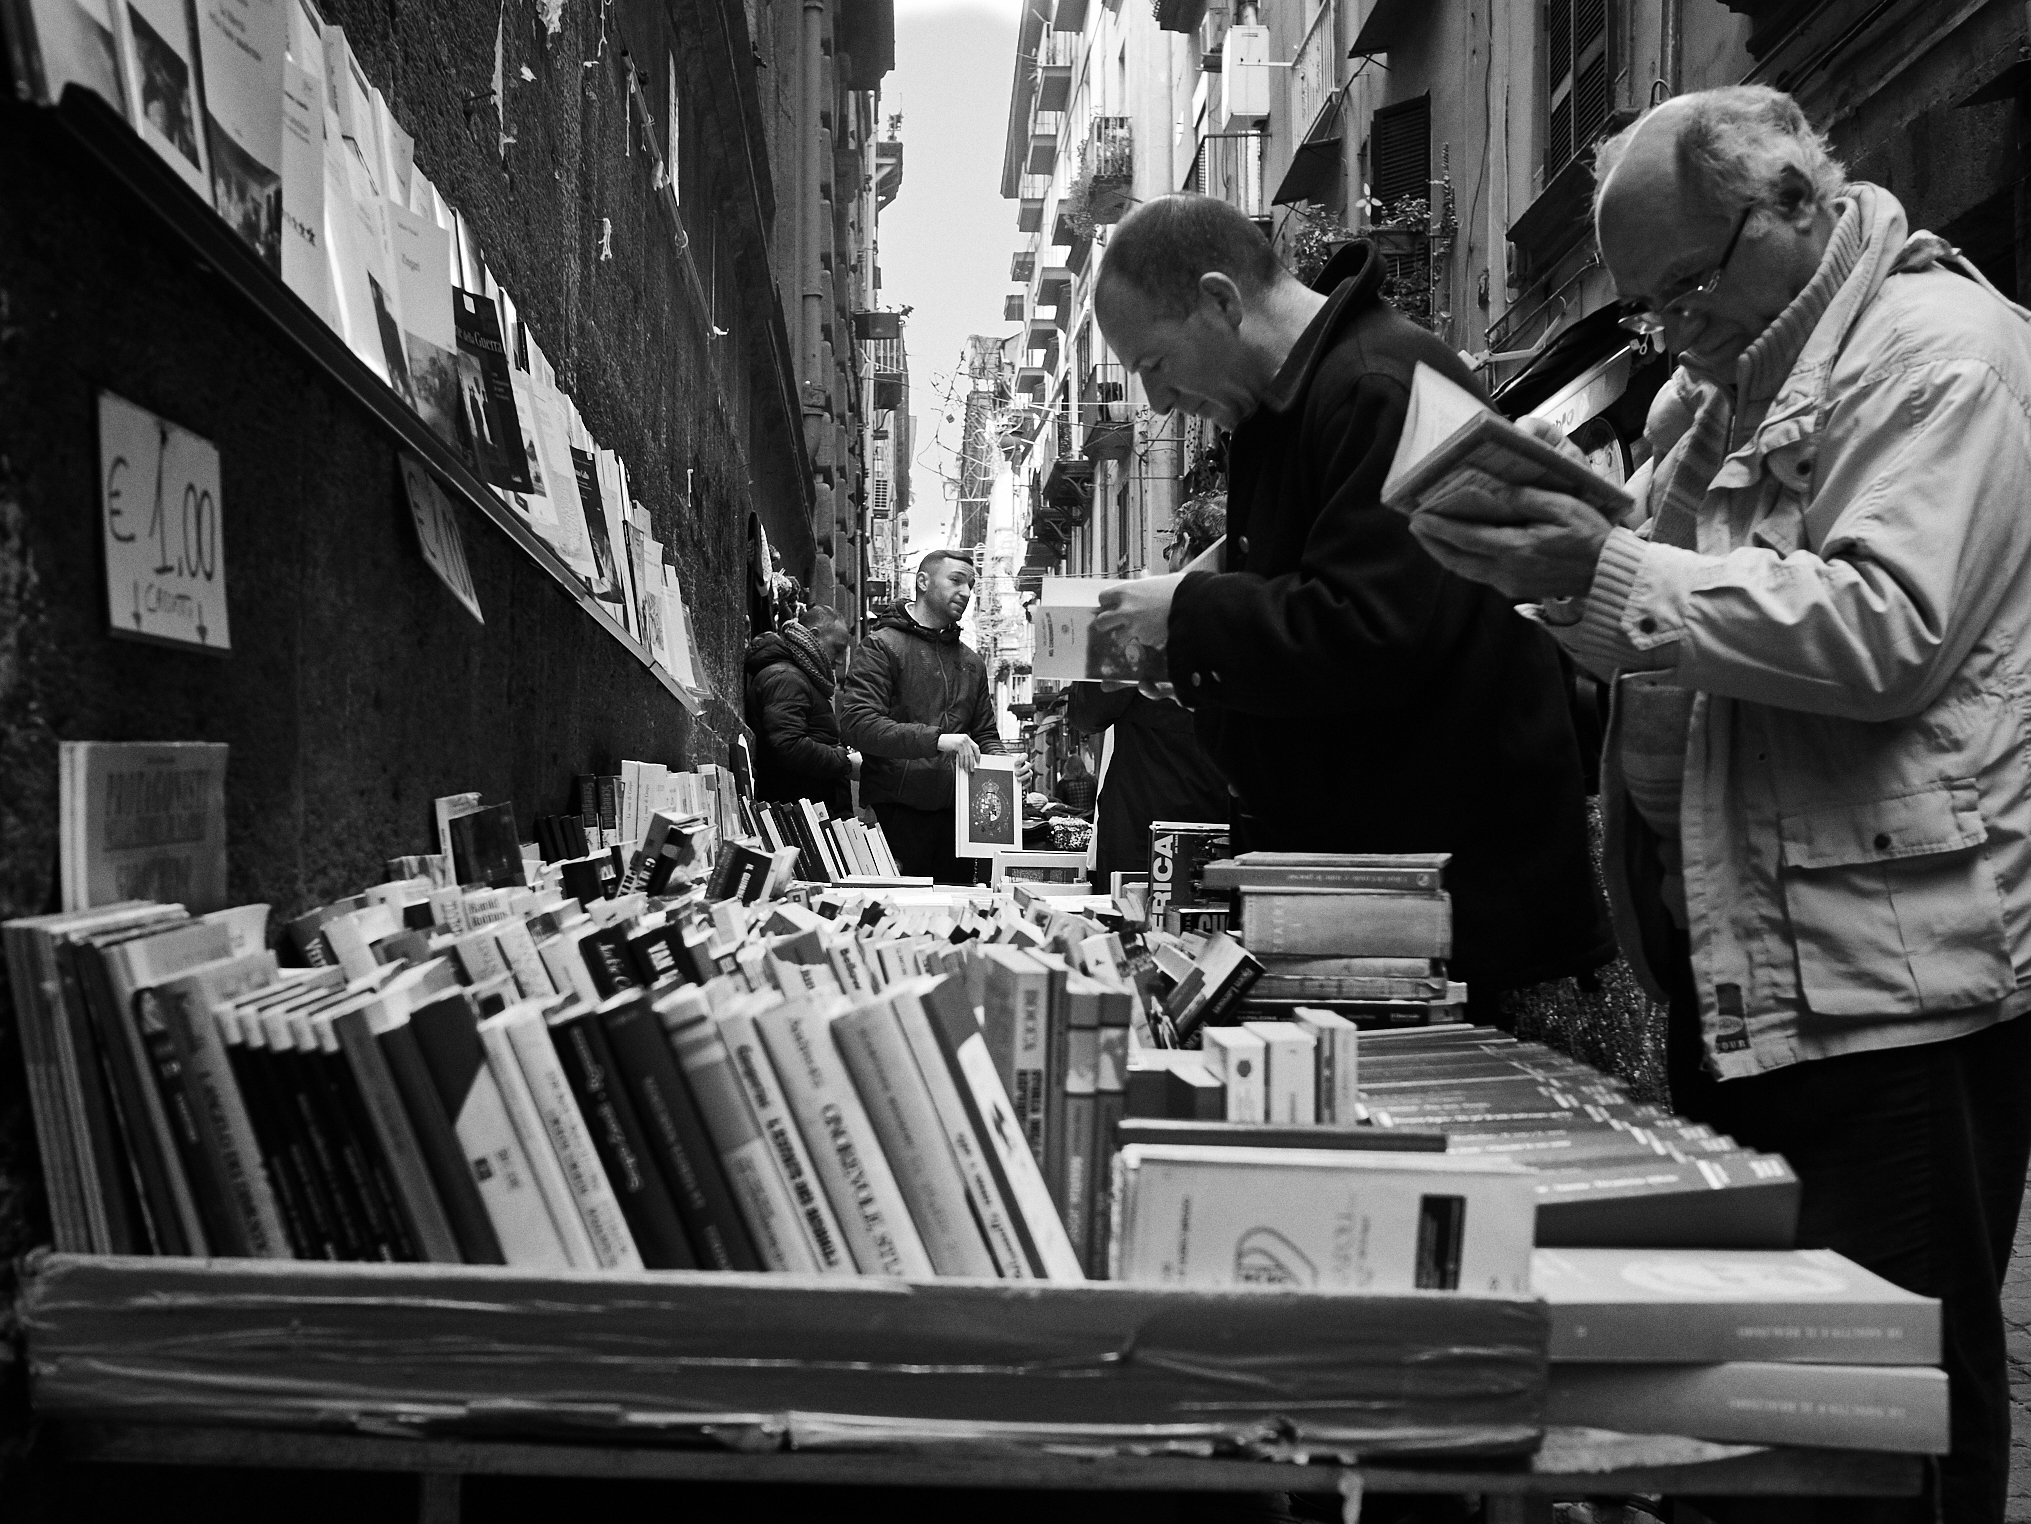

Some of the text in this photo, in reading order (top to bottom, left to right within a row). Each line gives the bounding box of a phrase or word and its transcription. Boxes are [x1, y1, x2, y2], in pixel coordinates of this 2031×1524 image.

[474, 331, 503, 354] Guerra
[106, 428, 216, 582] € 1,00
